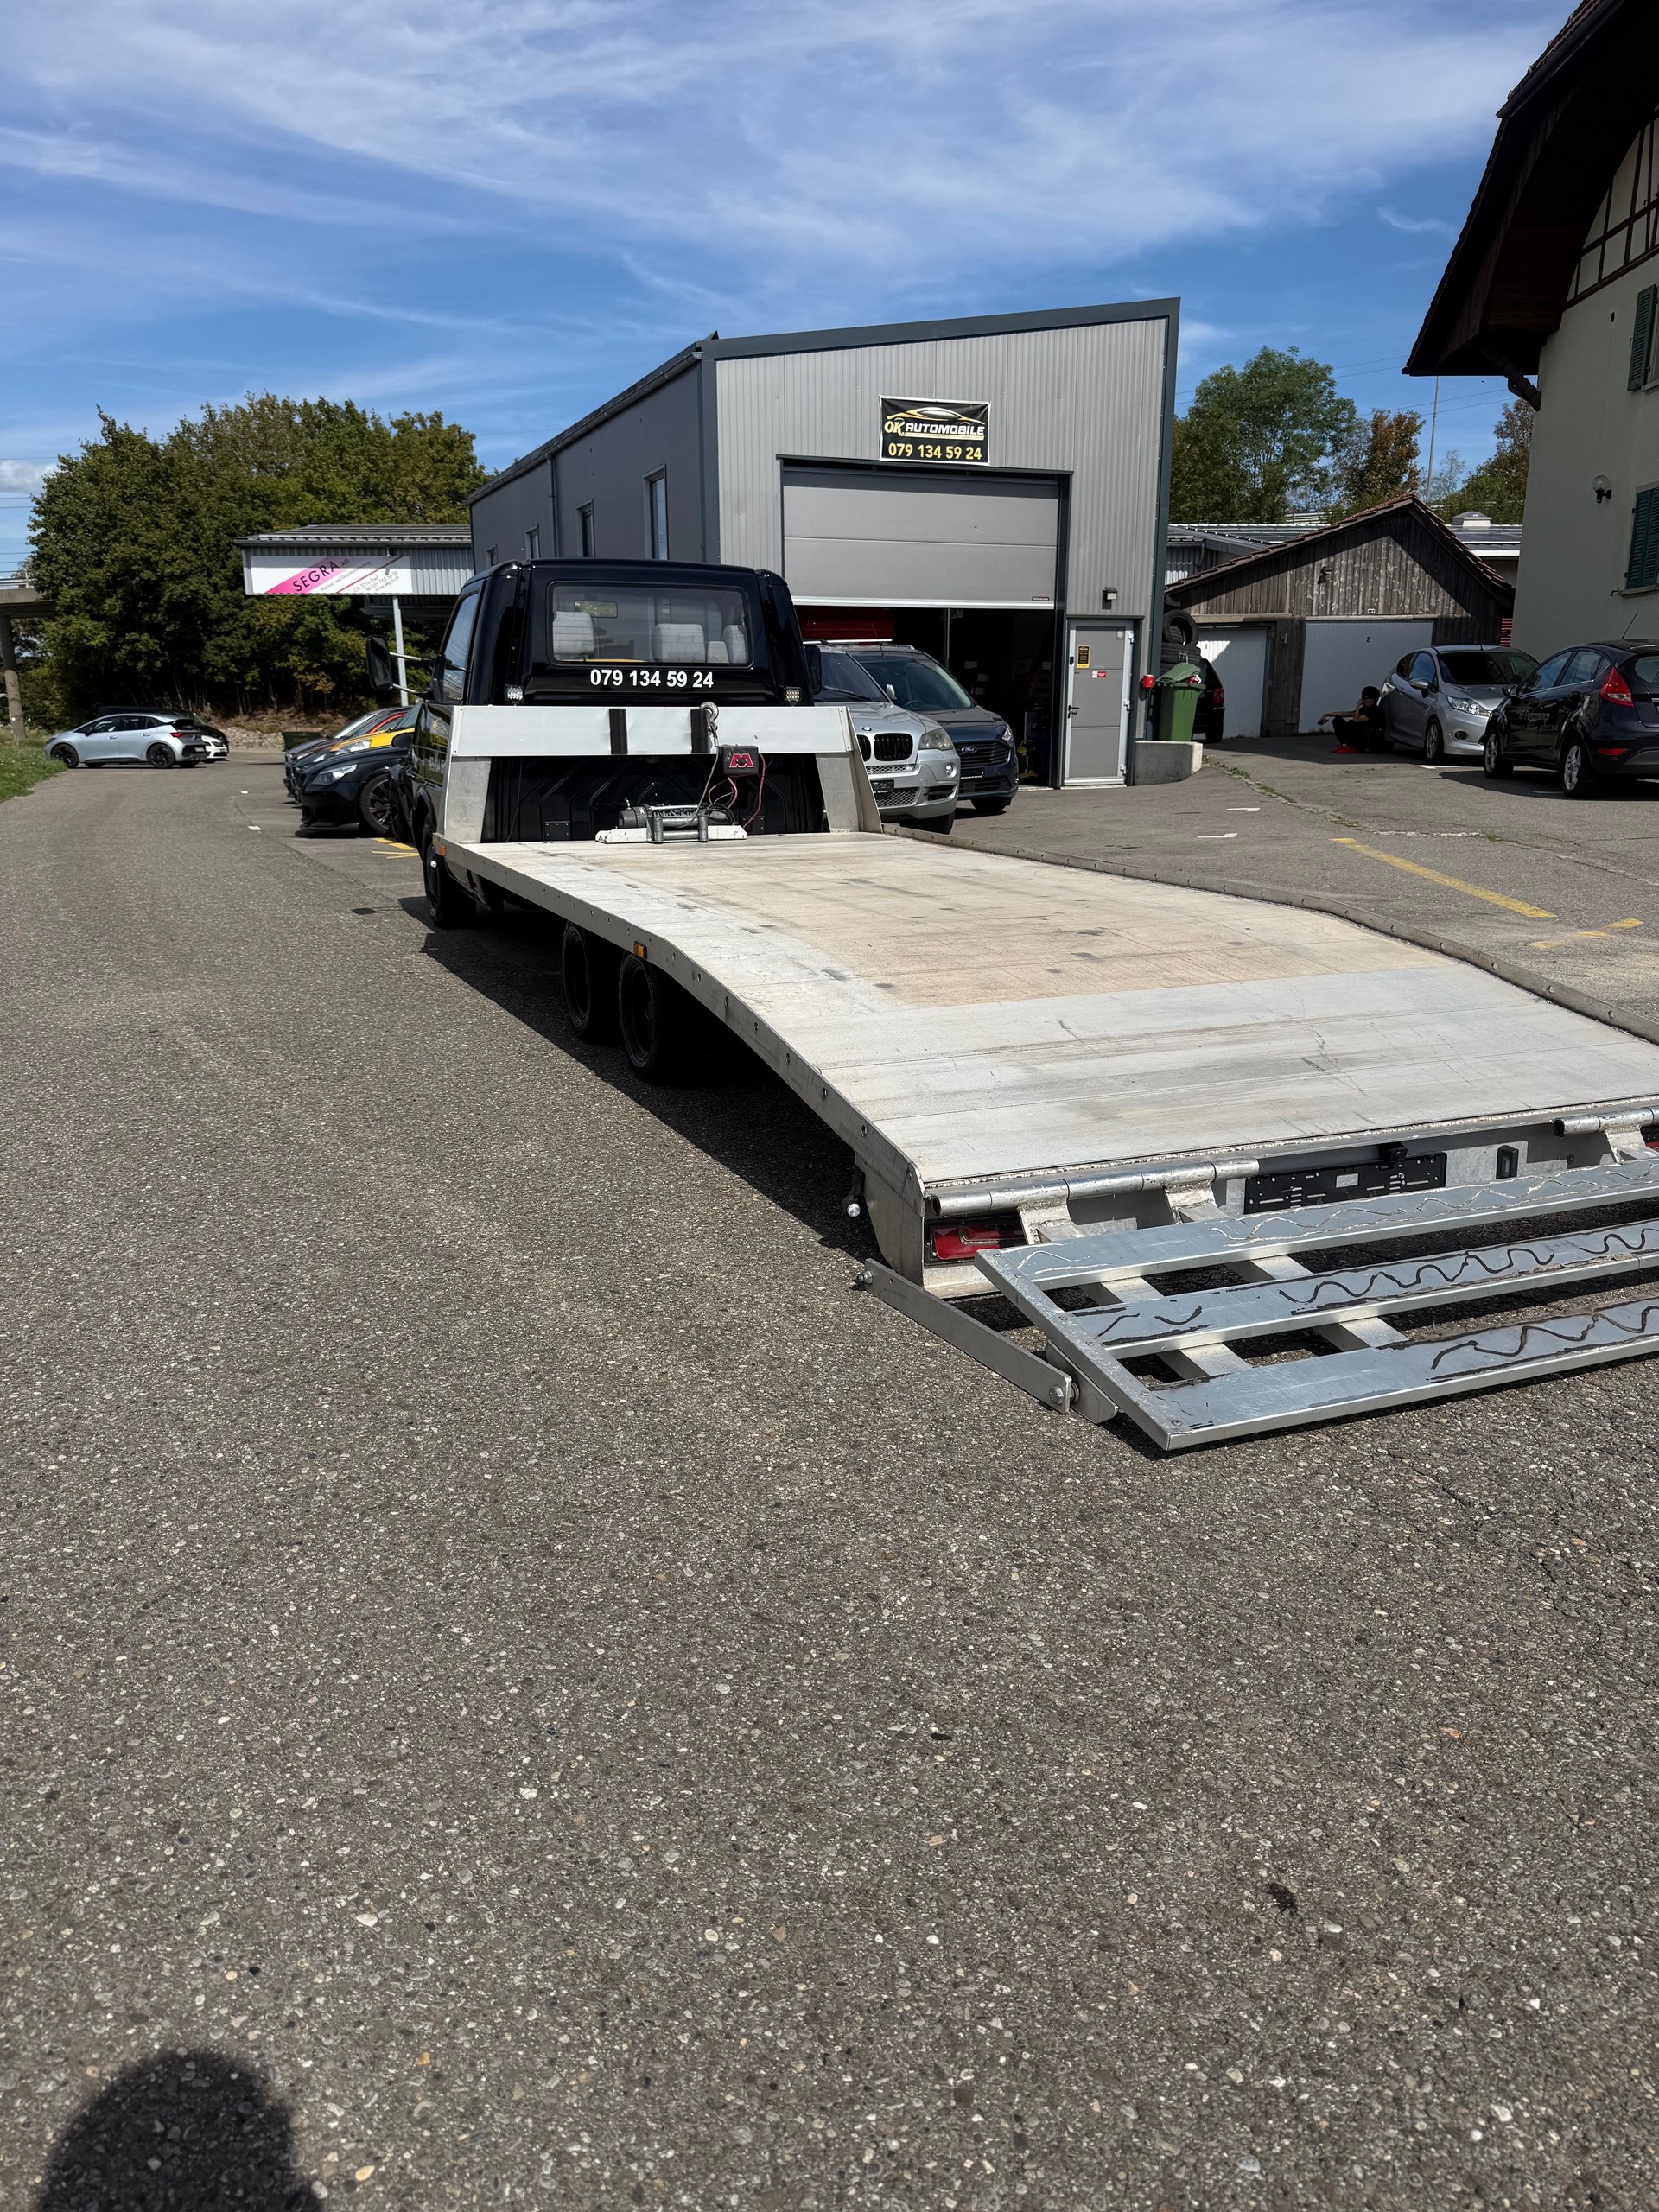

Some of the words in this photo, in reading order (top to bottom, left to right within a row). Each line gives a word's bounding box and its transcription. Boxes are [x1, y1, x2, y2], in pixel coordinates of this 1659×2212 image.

[884, 421, 905, 436] OK
[906, 423, 985, 435] AUTOMOBILE
[888, 442, 913, 457] 079
[918, 444, 942, 459] 134
[945, 446, 962, 459] 59
[965, 447, 982, 460] 24
[292, 561, 340, 592] SEGRA
[590, 669, 624, 686] 079
[629, 670, 661, 687] 134
[666, 671, 688, 688] 59
[692, 671, 714, 688] 24
